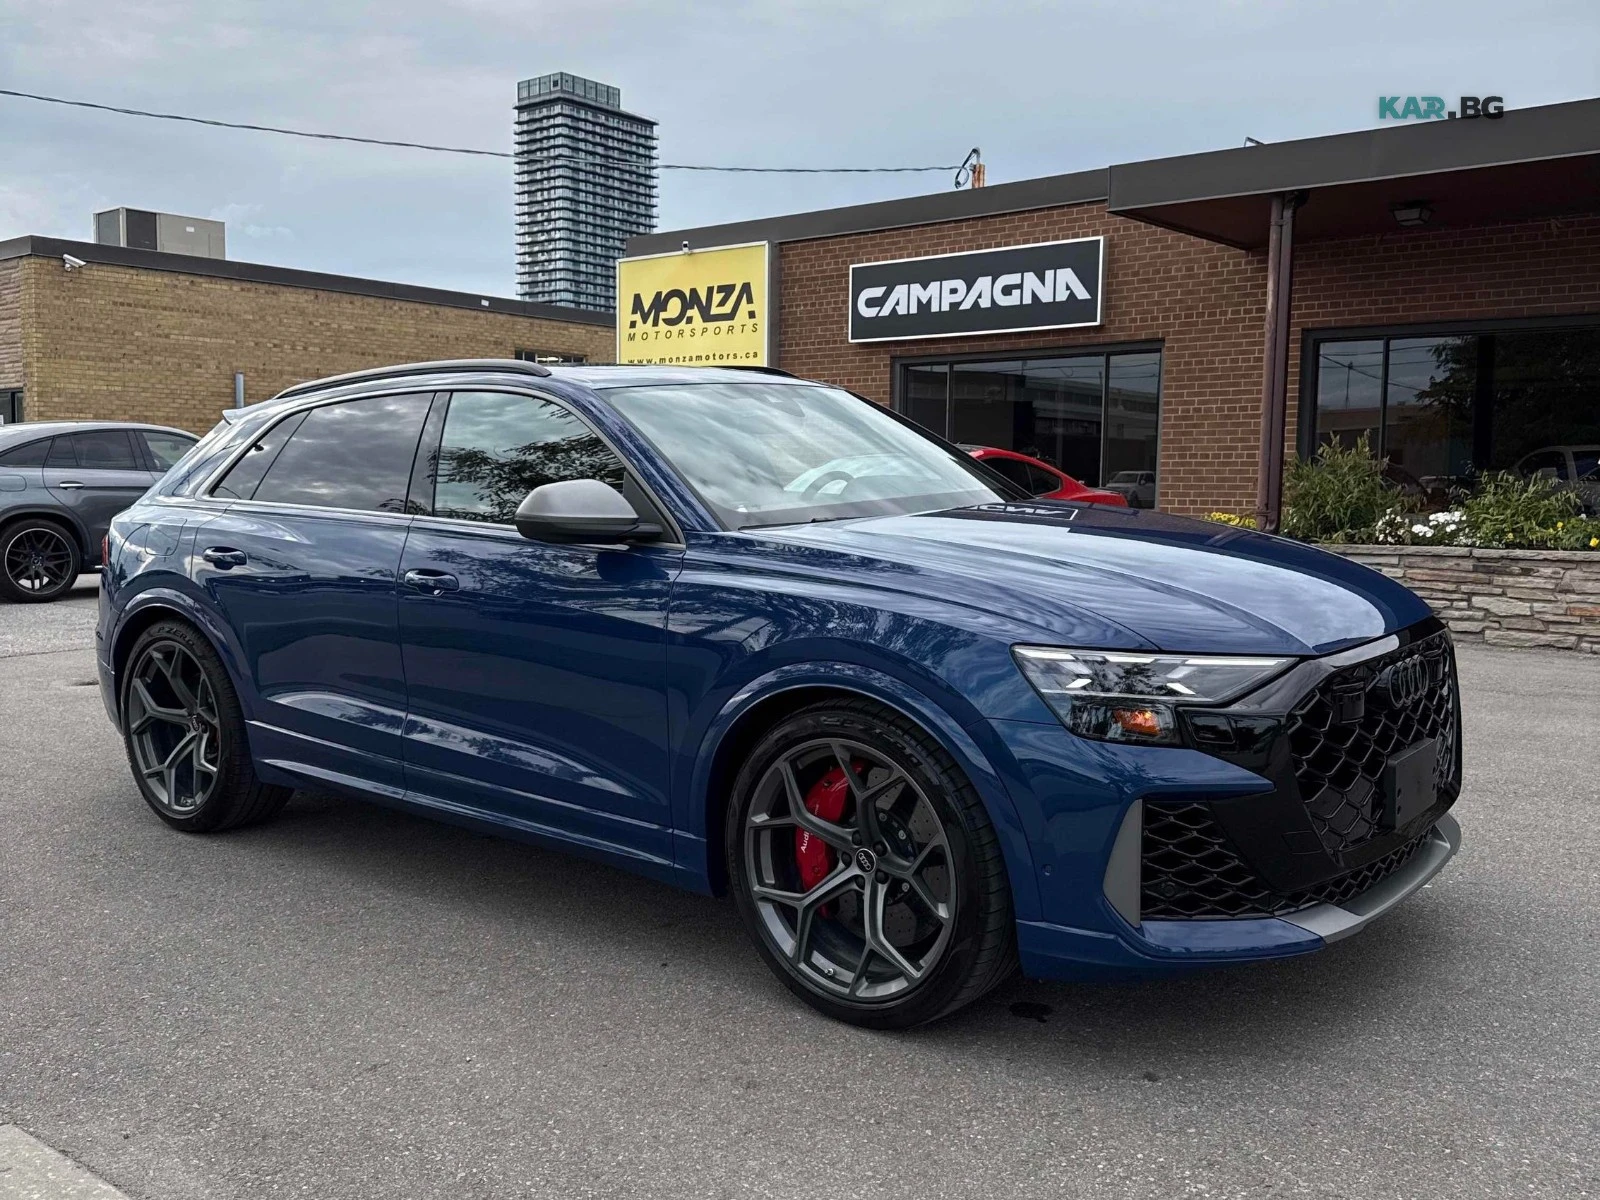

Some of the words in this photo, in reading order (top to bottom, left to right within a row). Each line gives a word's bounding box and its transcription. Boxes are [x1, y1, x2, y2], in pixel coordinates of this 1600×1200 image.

[857, 267, 1092, 318] CAMPAGNA
[629, 282, 756, 329] MONZA
[628, 323, 758, 342] MOTORSPORTS
[627, 351, 758, 365] www.monzamotors.ca
[800, 831, 810, 853] Audi
